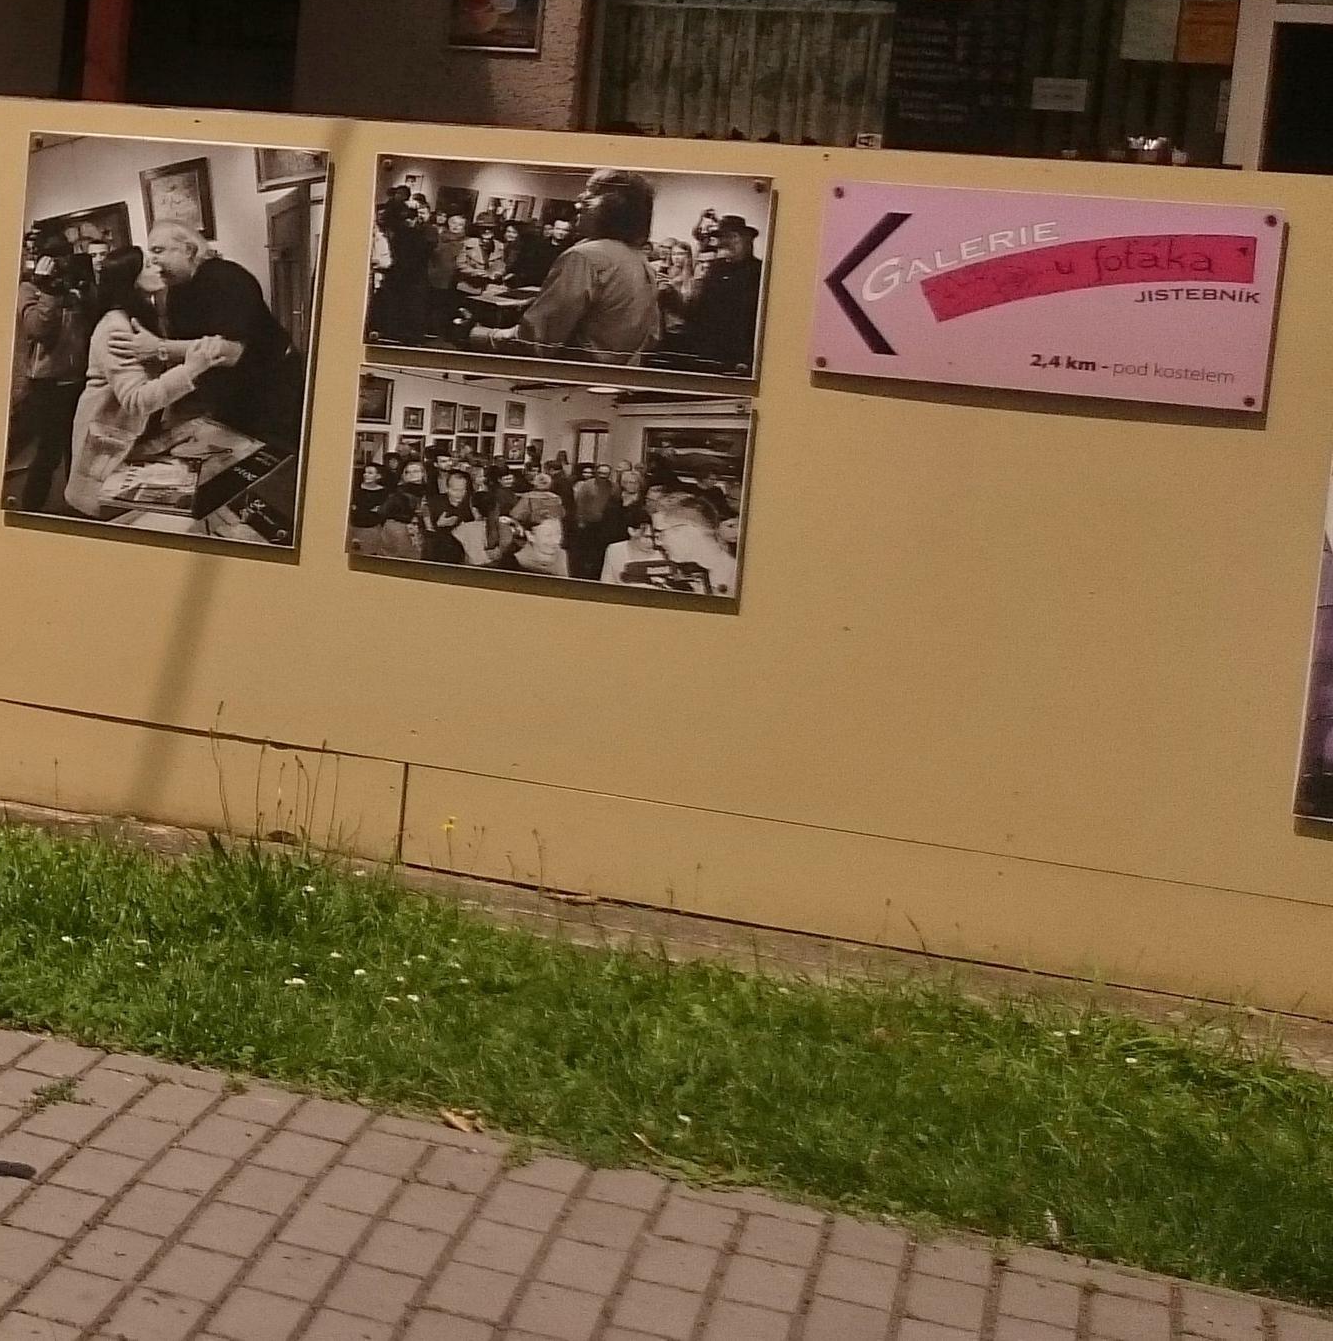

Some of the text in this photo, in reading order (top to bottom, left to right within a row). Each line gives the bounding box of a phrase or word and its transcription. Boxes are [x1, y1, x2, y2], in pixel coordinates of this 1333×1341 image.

[861, 222, 1060, 301] GALERIE
[1134, 286, 1261, 305] JISTEBNÍK
[1030, 354, 1061, 371] 2,4
[1066, 356, 1097, 372] km
[1112, 361, 1149, 378] pod
[1153, 365, 1235, 386] kostelem
